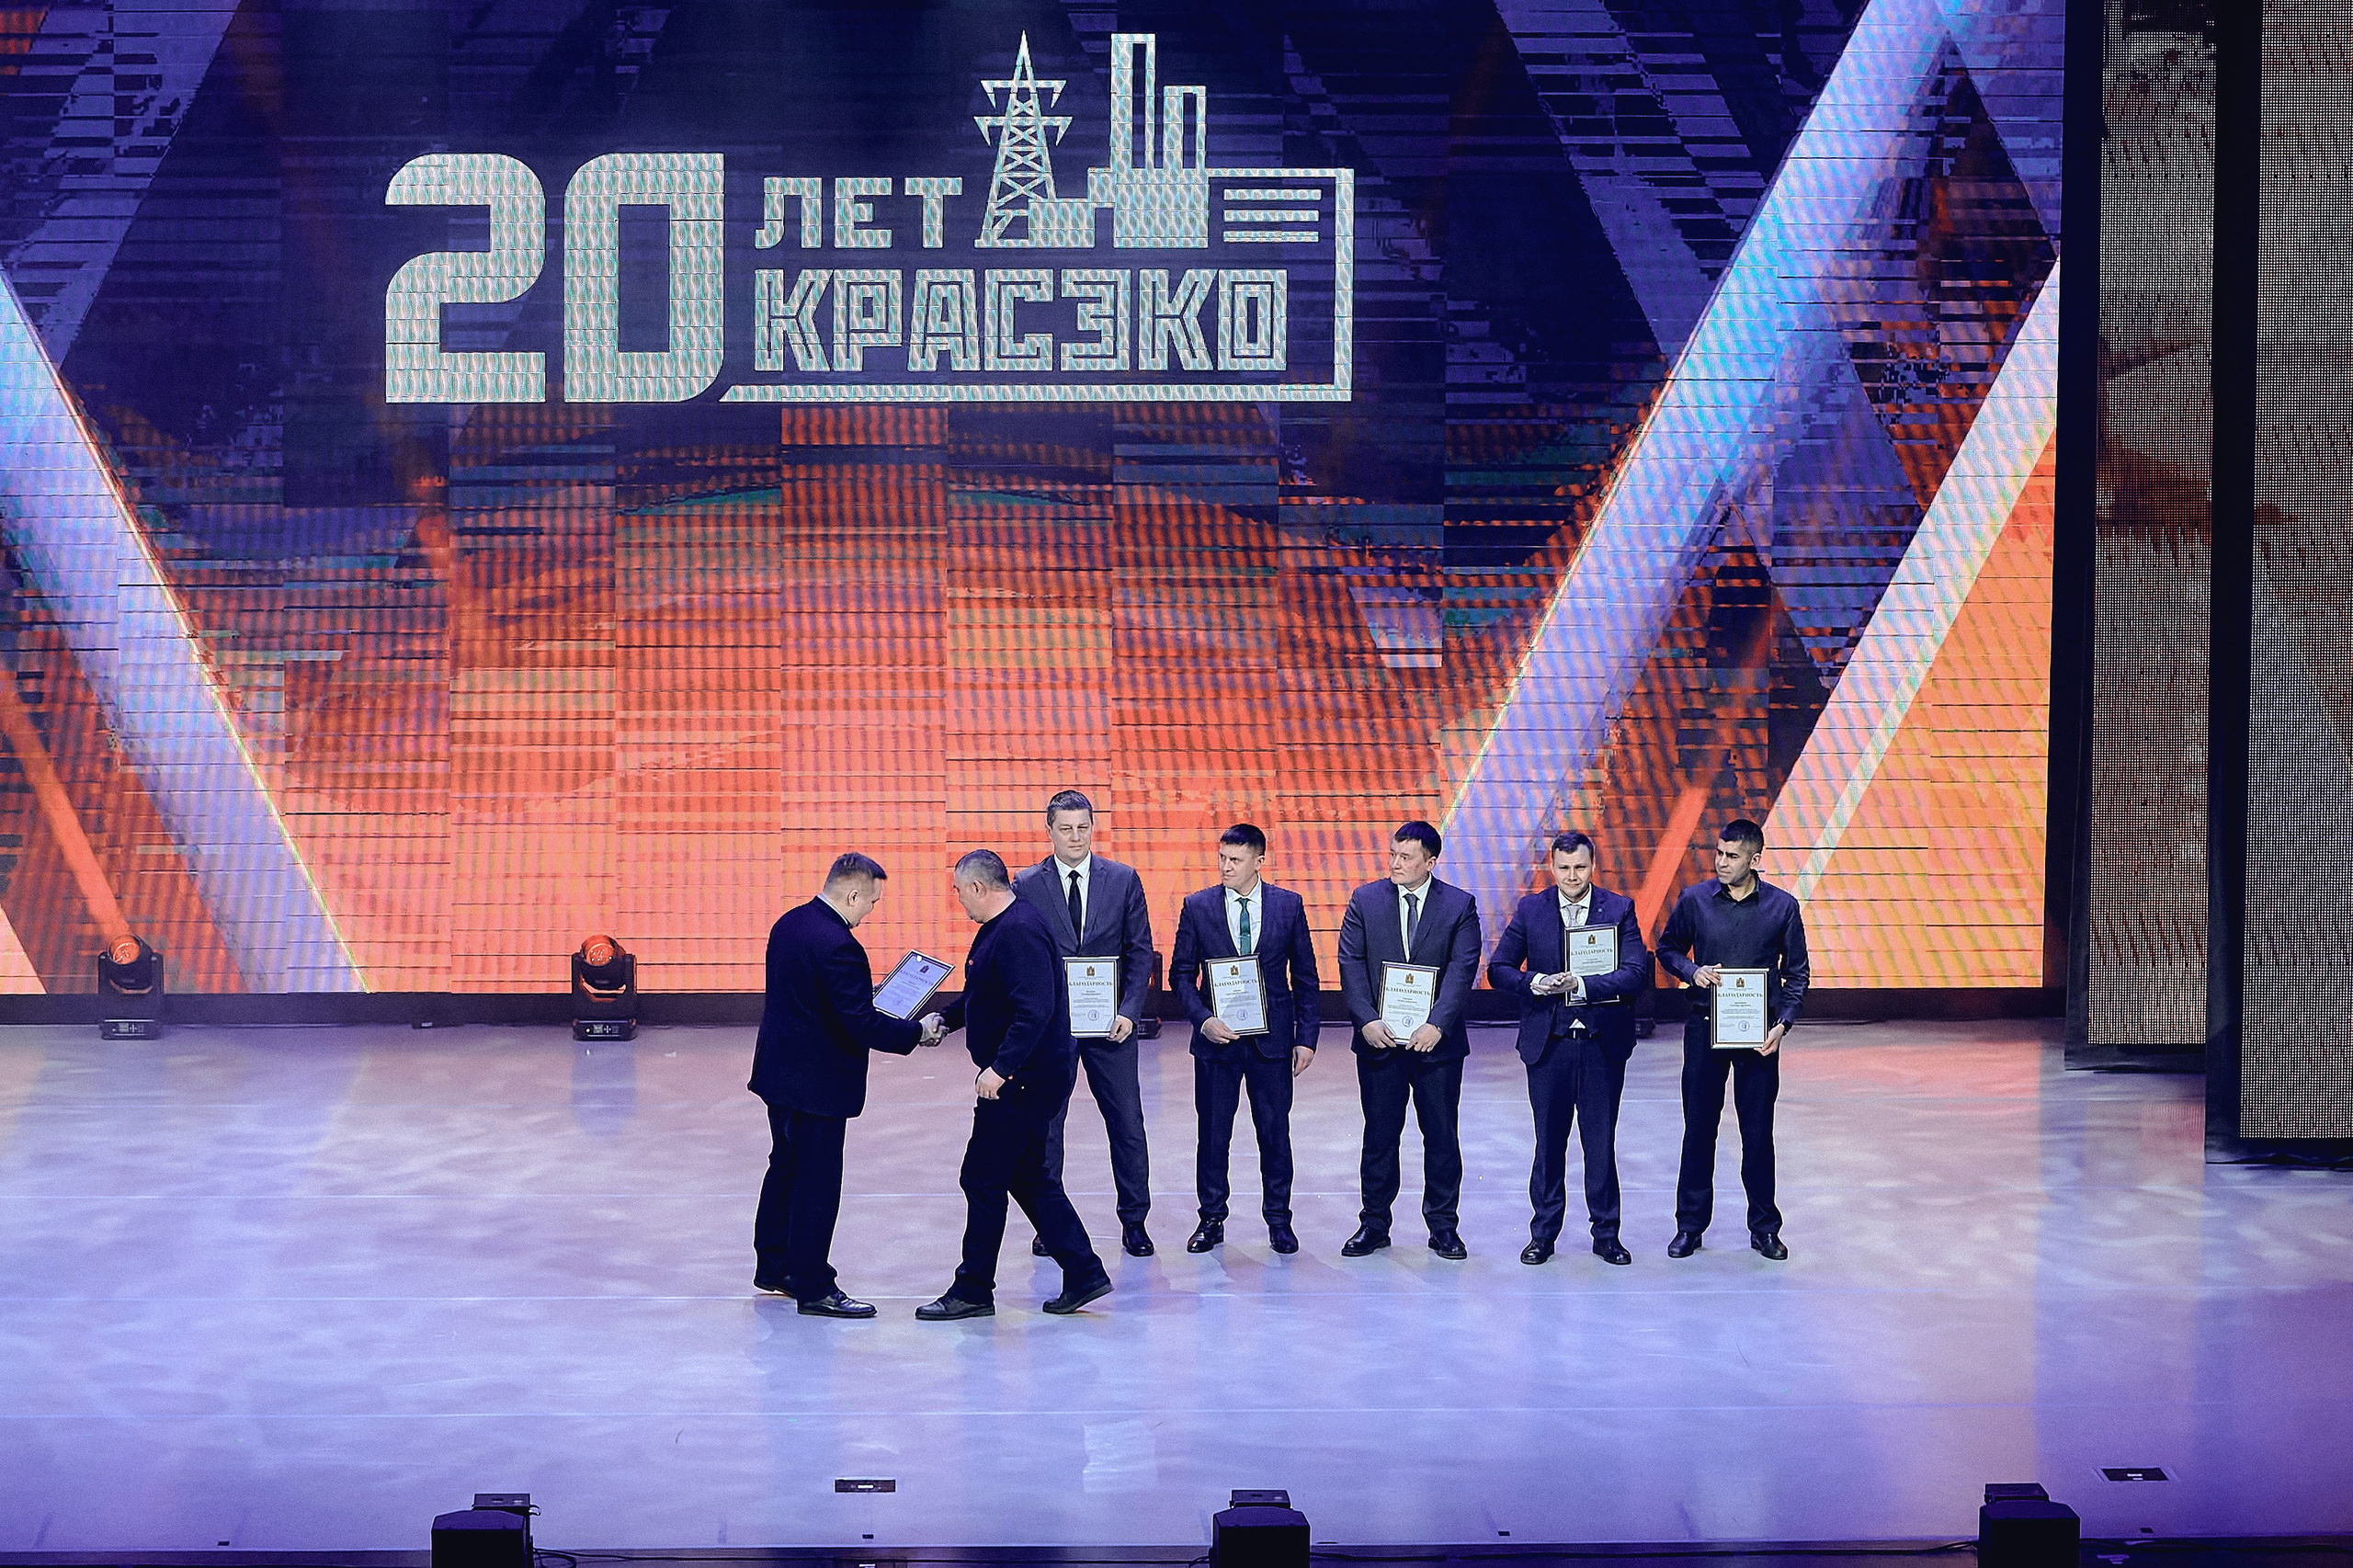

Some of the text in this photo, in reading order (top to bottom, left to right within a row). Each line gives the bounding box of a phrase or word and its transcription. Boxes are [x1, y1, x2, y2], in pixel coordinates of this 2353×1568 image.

[385, 152, 962, 403] 20 ЛЕТ
[754, 267, 1288, 372] КРАСЭКО
